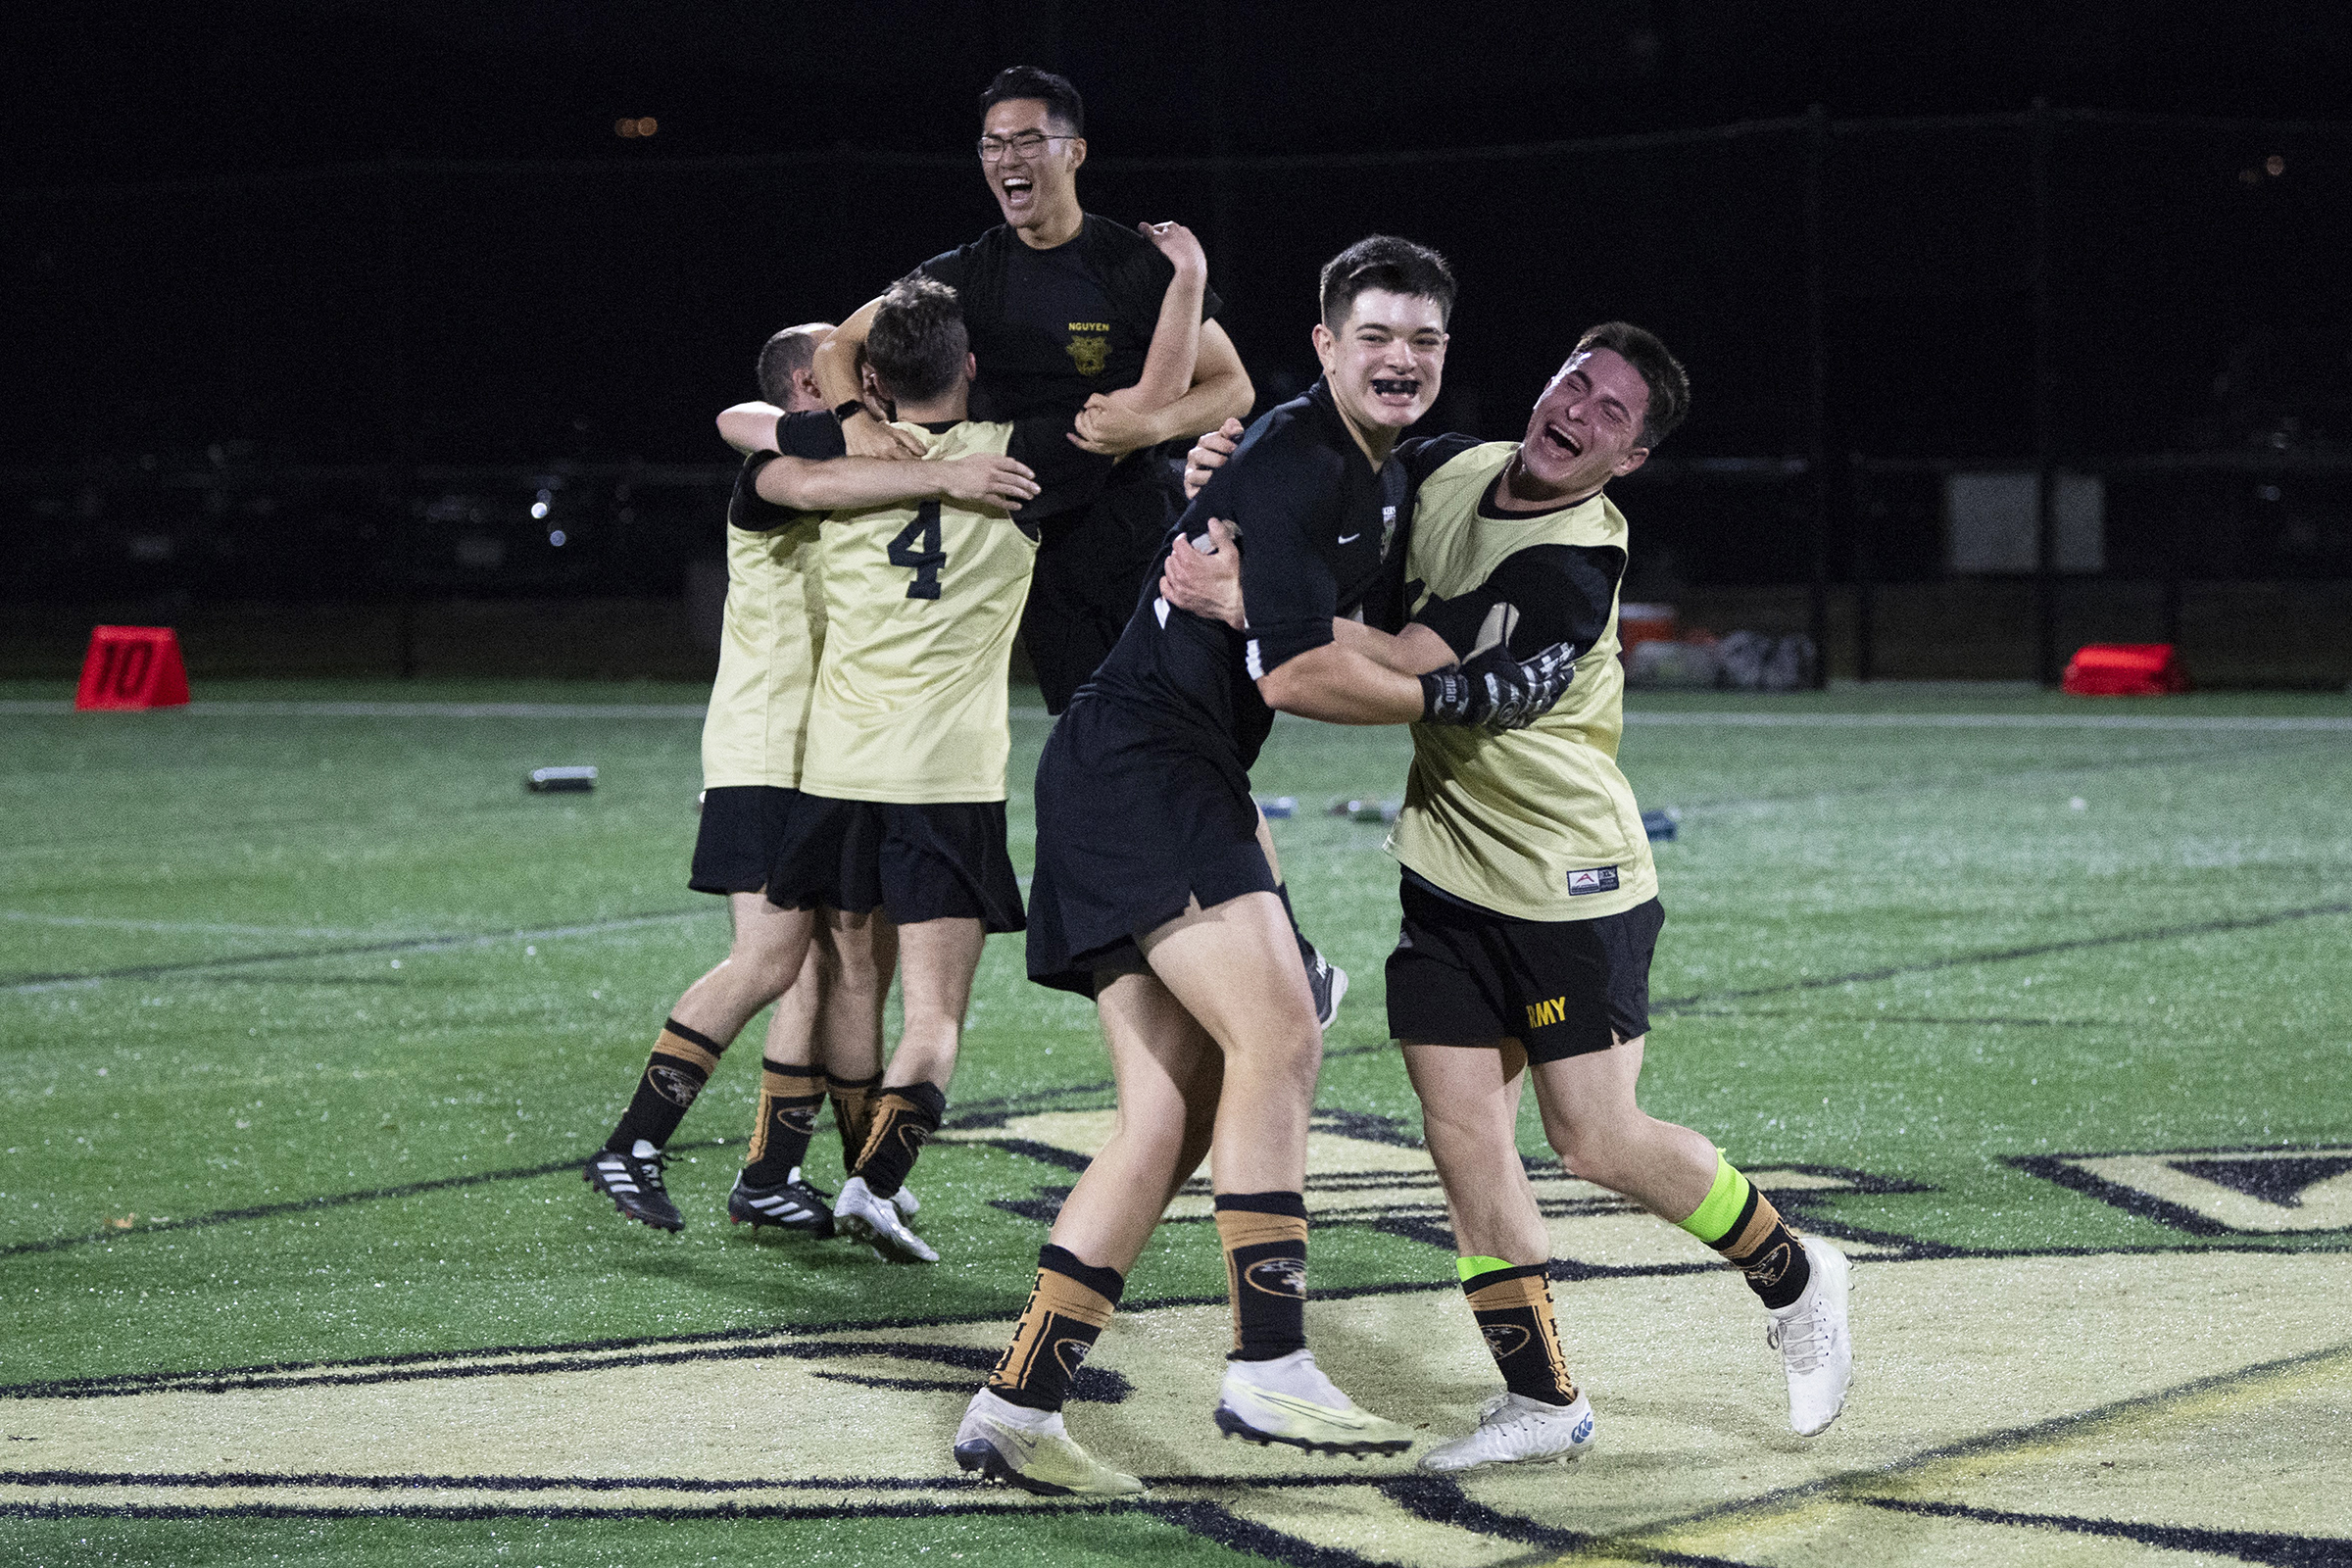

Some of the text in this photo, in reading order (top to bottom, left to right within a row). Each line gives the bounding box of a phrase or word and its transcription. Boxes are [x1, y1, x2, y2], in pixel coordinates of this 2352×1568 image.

[1068, 322, 1110, 331] NGUYEN
[886, 499, 948, 600] 4
[97, 640, 153, 699] 10
[1525, 996, 1566, 1029] RMY
